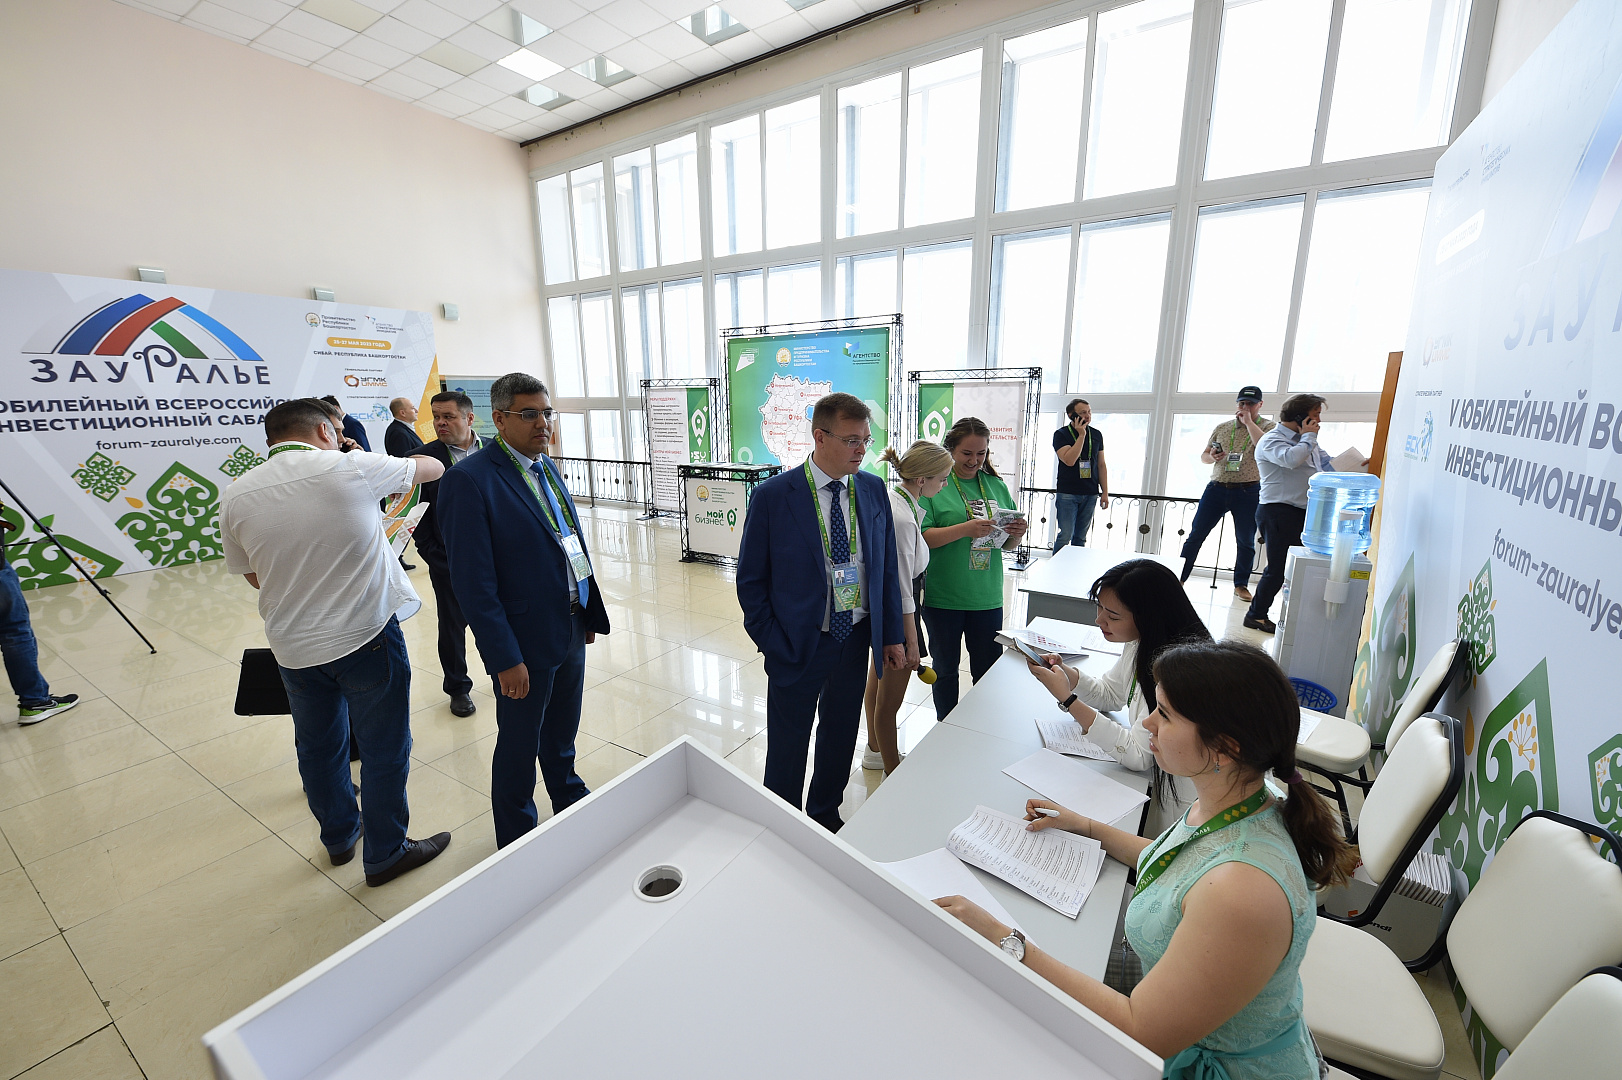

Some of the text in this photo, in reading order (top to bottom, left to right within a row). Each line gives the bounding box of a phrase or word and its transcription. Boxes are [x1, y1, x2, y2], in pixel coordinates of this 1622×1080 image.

[1503, 252, 1622, 350] ЗАУ
[29, 344, 271, 384] ЗАУРАЛЬЕ
[156, 396, 318, 411] ВСЕРОССИЙ
[0, 413, 266, 433] НВЕСТИЦИОННЫЙ САБА
[1449, 398, 1460, 428] V
[1458, 389, 1588, 446] ЮБИЛЕЙНЫЙ
[96, 436, 242, 451] forum-zauralye.com
[695, 513, 724, 526] бизнес
[706, 510, 724, 518] мой
